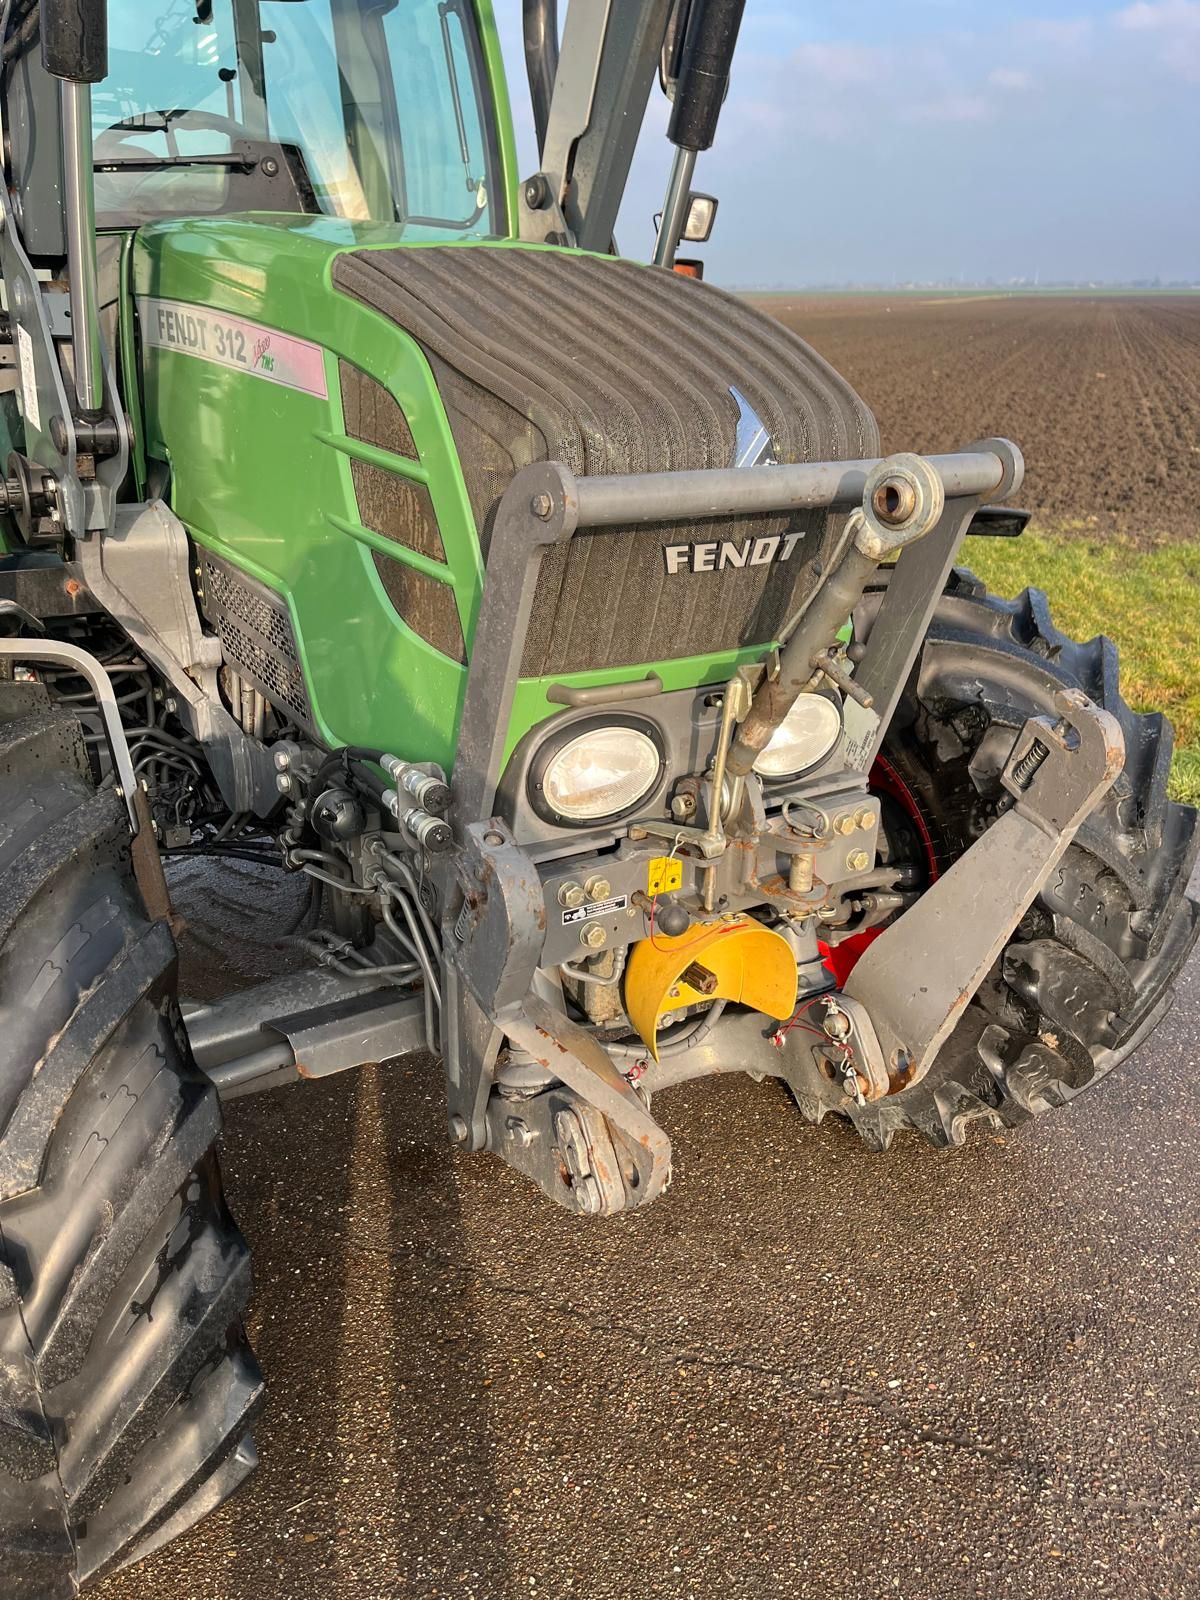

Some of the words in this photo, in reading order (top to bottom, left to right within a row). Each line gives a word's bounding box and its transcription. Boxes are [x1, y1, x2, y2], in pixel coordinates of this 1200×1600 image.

[157, 309, 206, 351] FENDT
[214, 324, 247, 364] 312
[261, 354, 274, 372] TMS
[663, 532, 806, 574] FENDT
